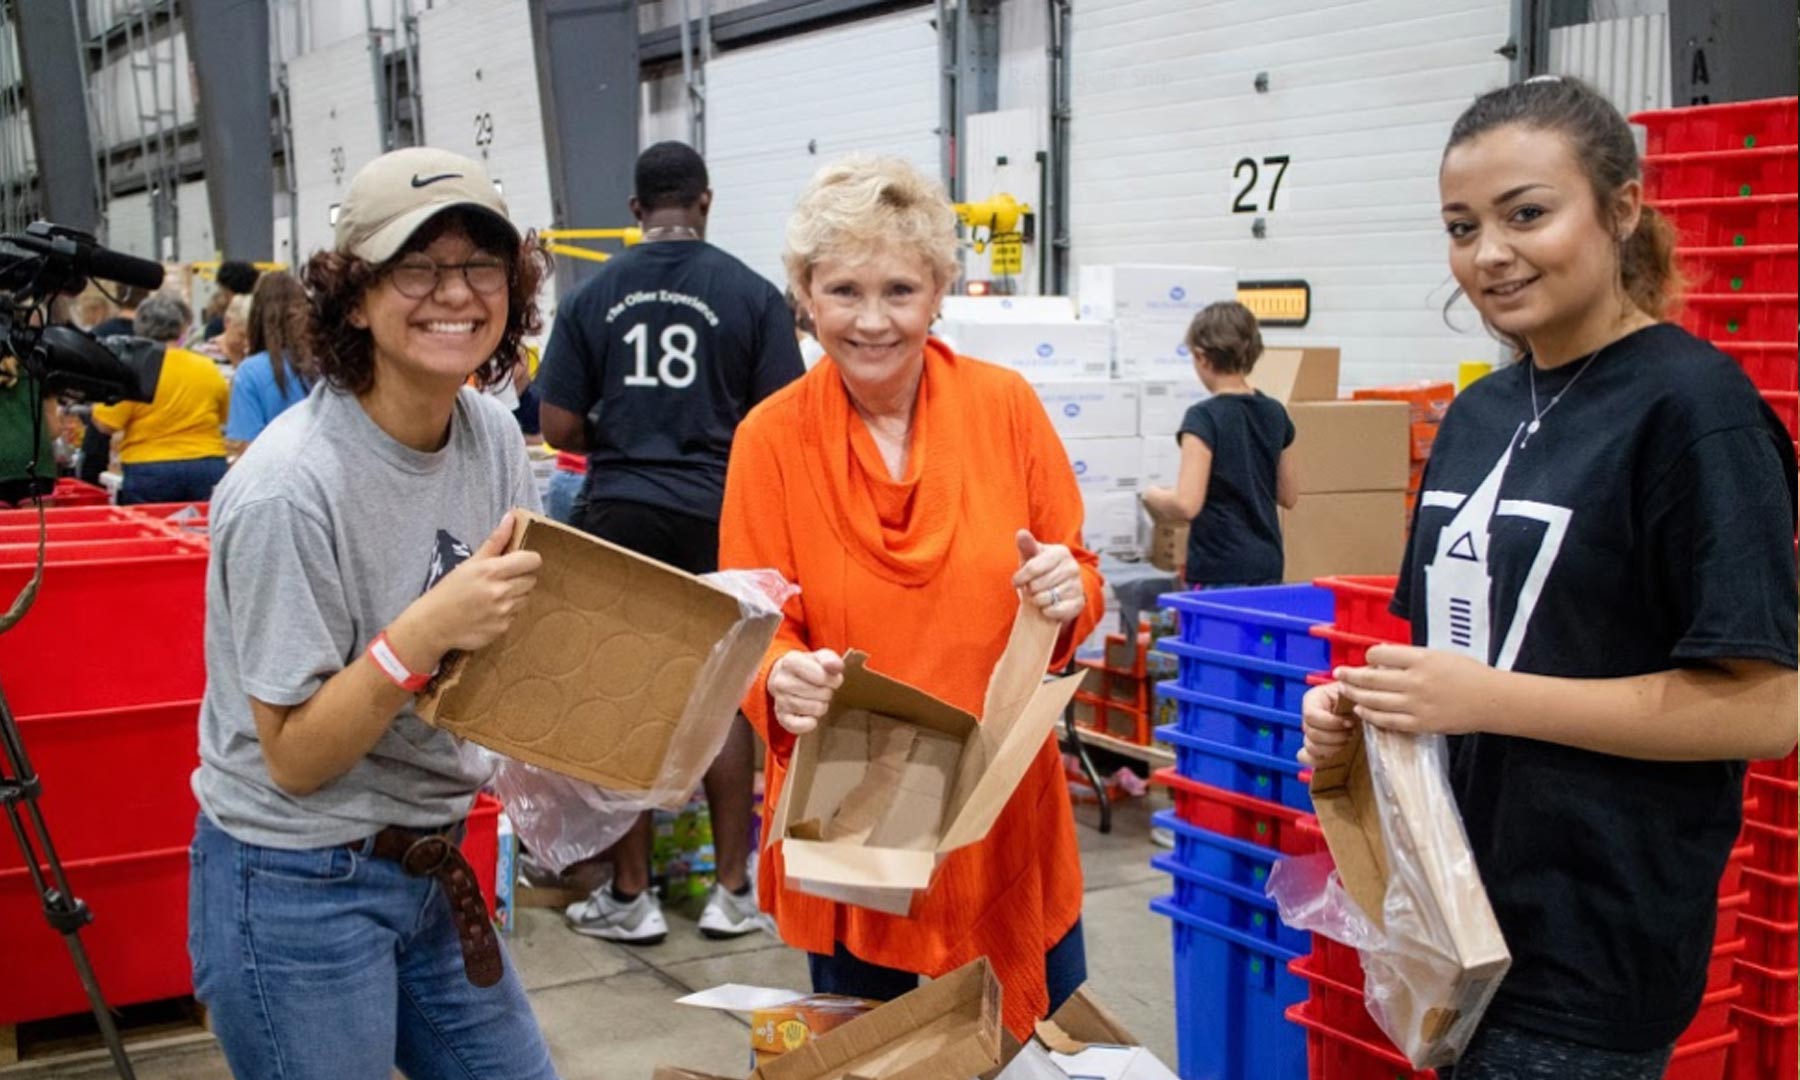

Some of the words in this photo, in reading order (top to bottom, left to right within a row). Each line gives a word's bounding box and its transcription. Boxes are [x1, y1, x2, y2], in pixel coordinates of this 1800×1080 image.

[475, 112, 493, 147] 29
[1232, 155, 1290, 213] 27
[658, 289, 720, 328] Experience
[622, 322, 697, 389] 18
